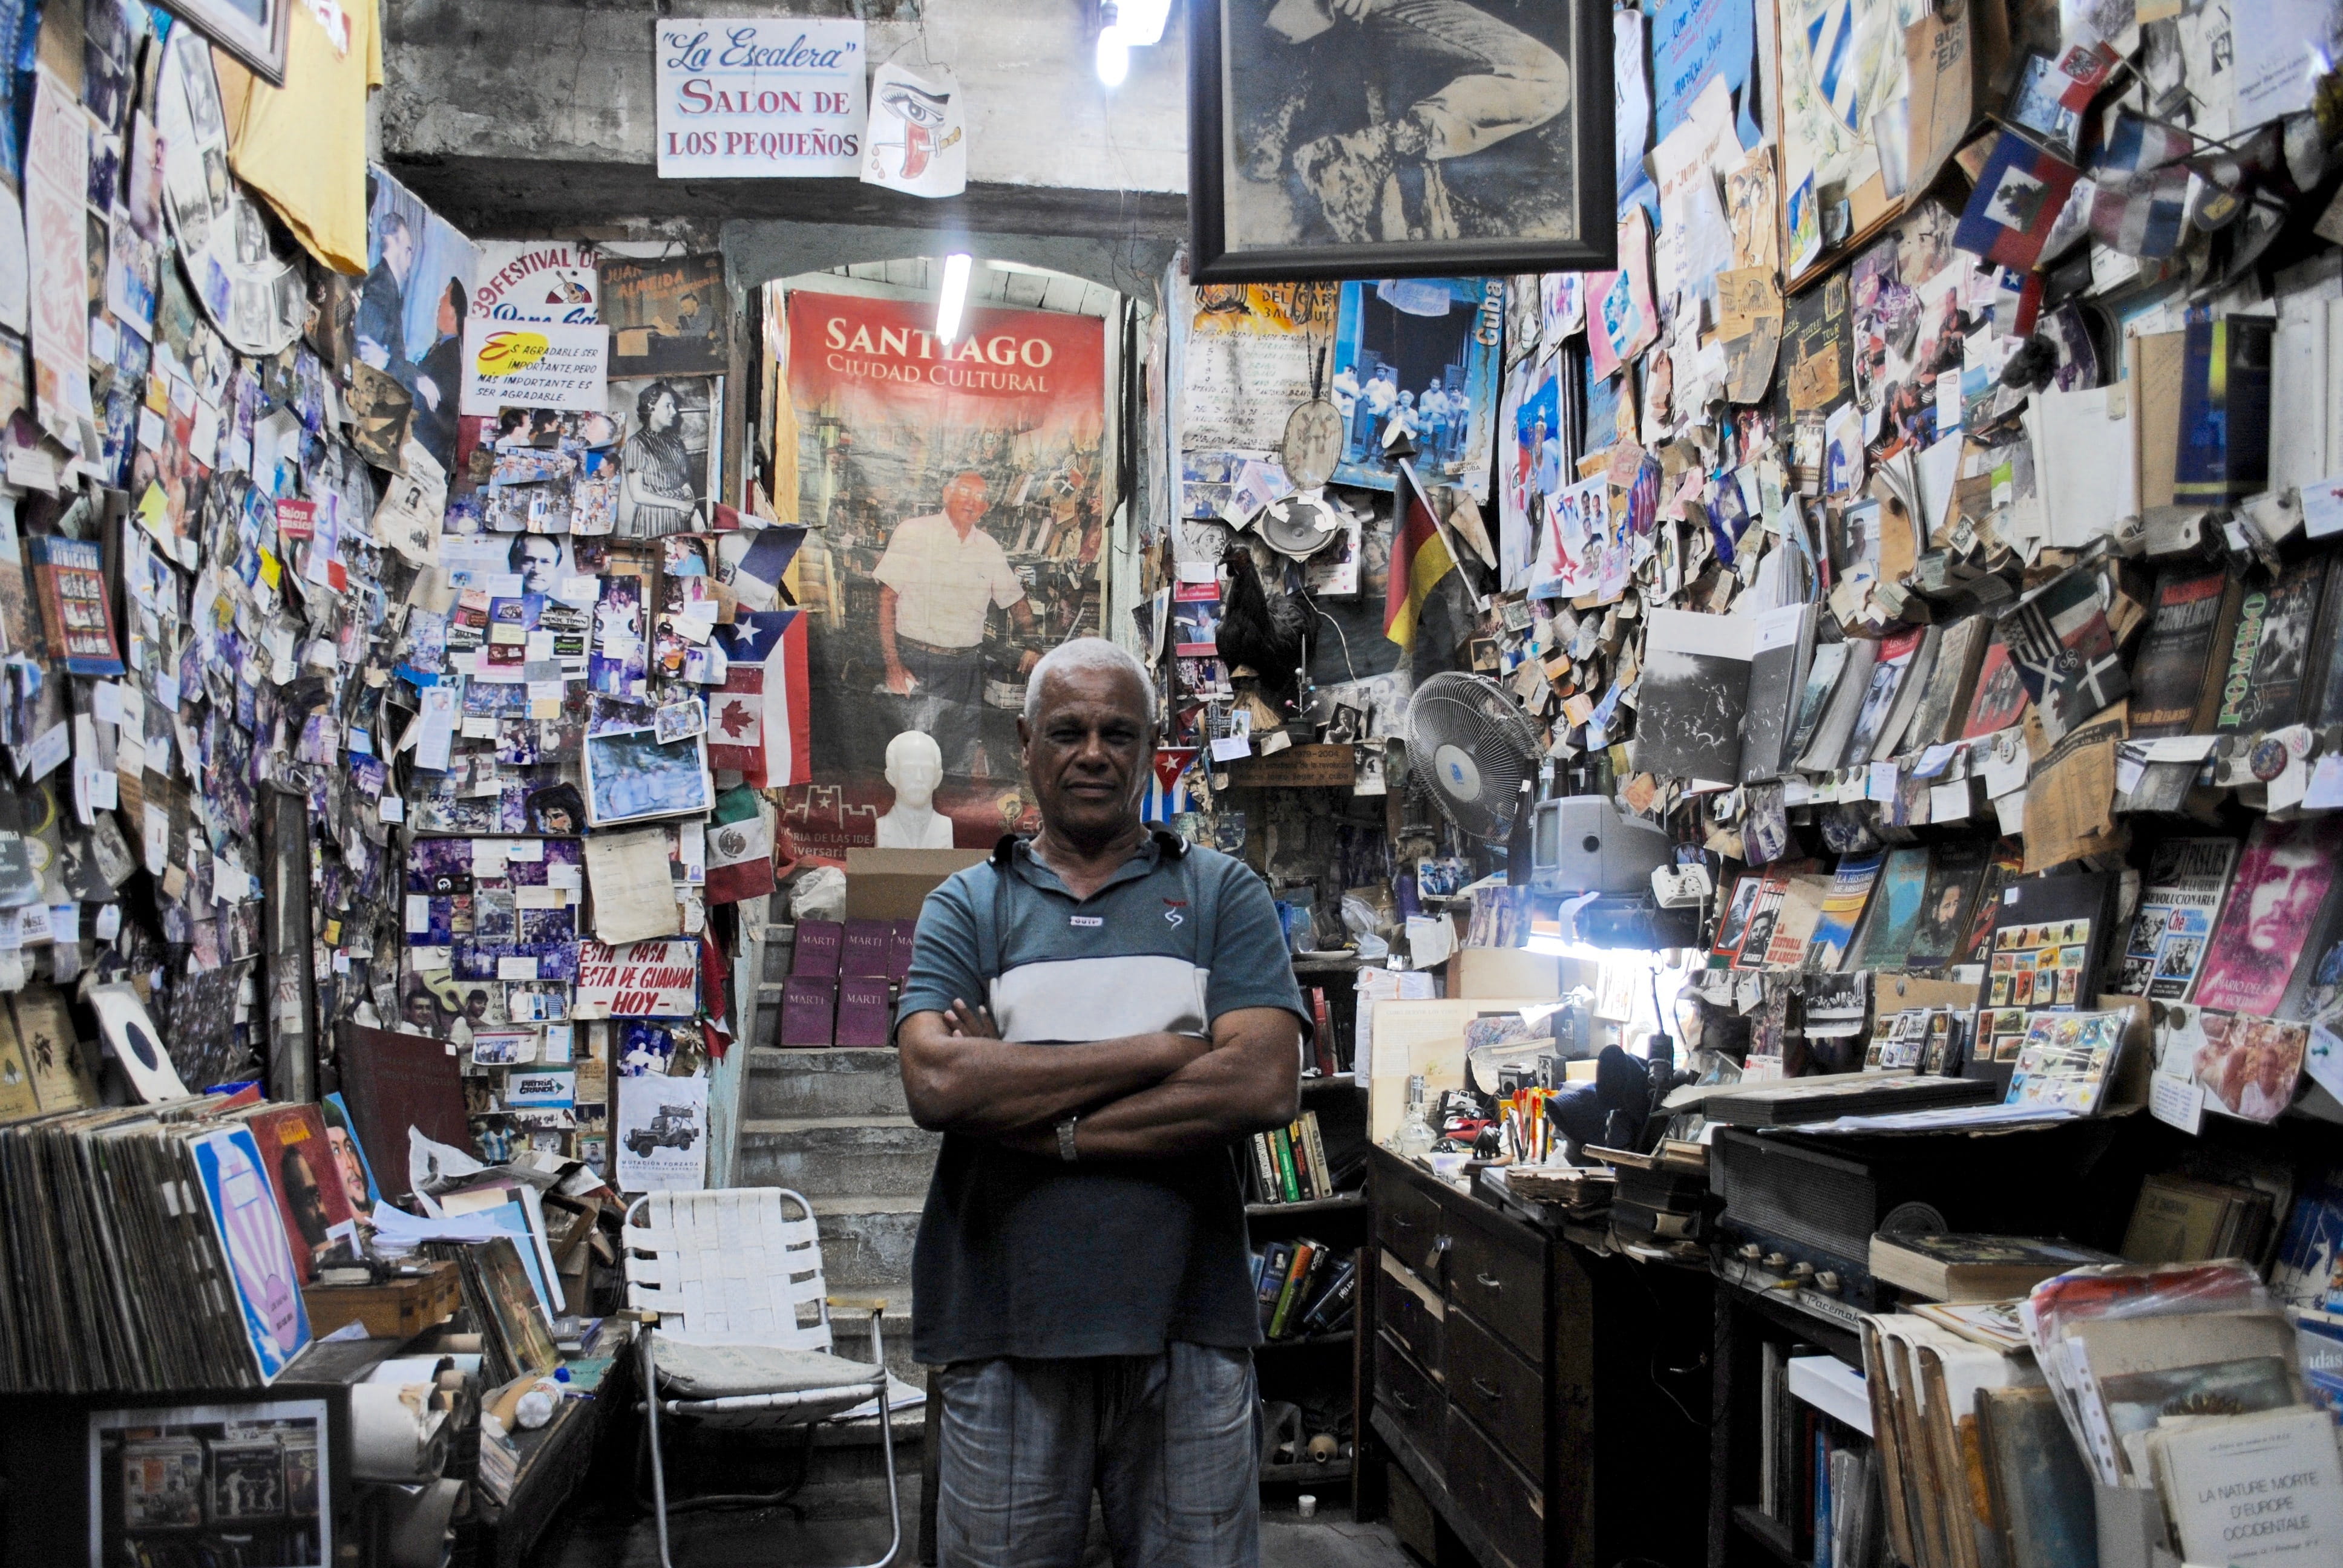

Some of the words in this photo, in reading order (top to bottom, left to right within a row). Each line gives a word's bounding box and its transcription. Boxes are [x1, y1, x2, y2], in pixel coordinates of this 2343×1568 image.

[724, 27, 856, 69] Escalera"
[812, 91, 850, 116] DE
[667, 131, 716, 157] LOS
[724, 126, 859, 158] PEQUEÑOS
[491, 248, 571, 295] FESTIVAL
[617, 270, 686, 299] ALMEIDA
[1475, 281, 1503, 347] Cuba
[523, 345, 579, 358] AGRADABLE
[581, 348, 598, 358] SER
[825, 318, 1053, 368] SANTIAGO
[574, 363, 597, 374] PERO
[827, 354, 922, 383] CIUDAD
[929, 364, 1049, 393] CULTURAL
[476, 387, 497, 397] SER
[500, 389, 566, 402] AGRADABLE.
[578, 379, 593, 390] ES
[814, 833, 827, 843] DE
[831, 834, 848, 844] LAS
[853, 835, 876, 844] IDEA
[2145, 892, 2216, 906] REVOLUCIONARIA
[2168, 907, 2185, 932] Che
[579, 942, 616, 964] ESTA
[628, 941, 669, 964] CASA
[802, 935, 837, 946] MARTI
[849, 935, 882, 947] MARTI
[1771, 937, 1803, 950] HISTORIA
[618, 967, 637, 988] DE
[639, 966, 694, 990] GUARDIA
[611, 990, 660, 1016] HOY
[790, 995, 824, 1005] MARTI
[847, 994, 881, 1005] MARTI
[519, 1086, 555, 1096] GRANDE
[1806, 1295, 1860, 1323] Pacemak
[2198, 1489, 2216, 1504] LA
[2218, 1478, 2269, 1500] NATURE
[2270, 1470, 2320, 1491] MORTE
[2223, 1515, 2311, 1542] OCCIDENTALE
